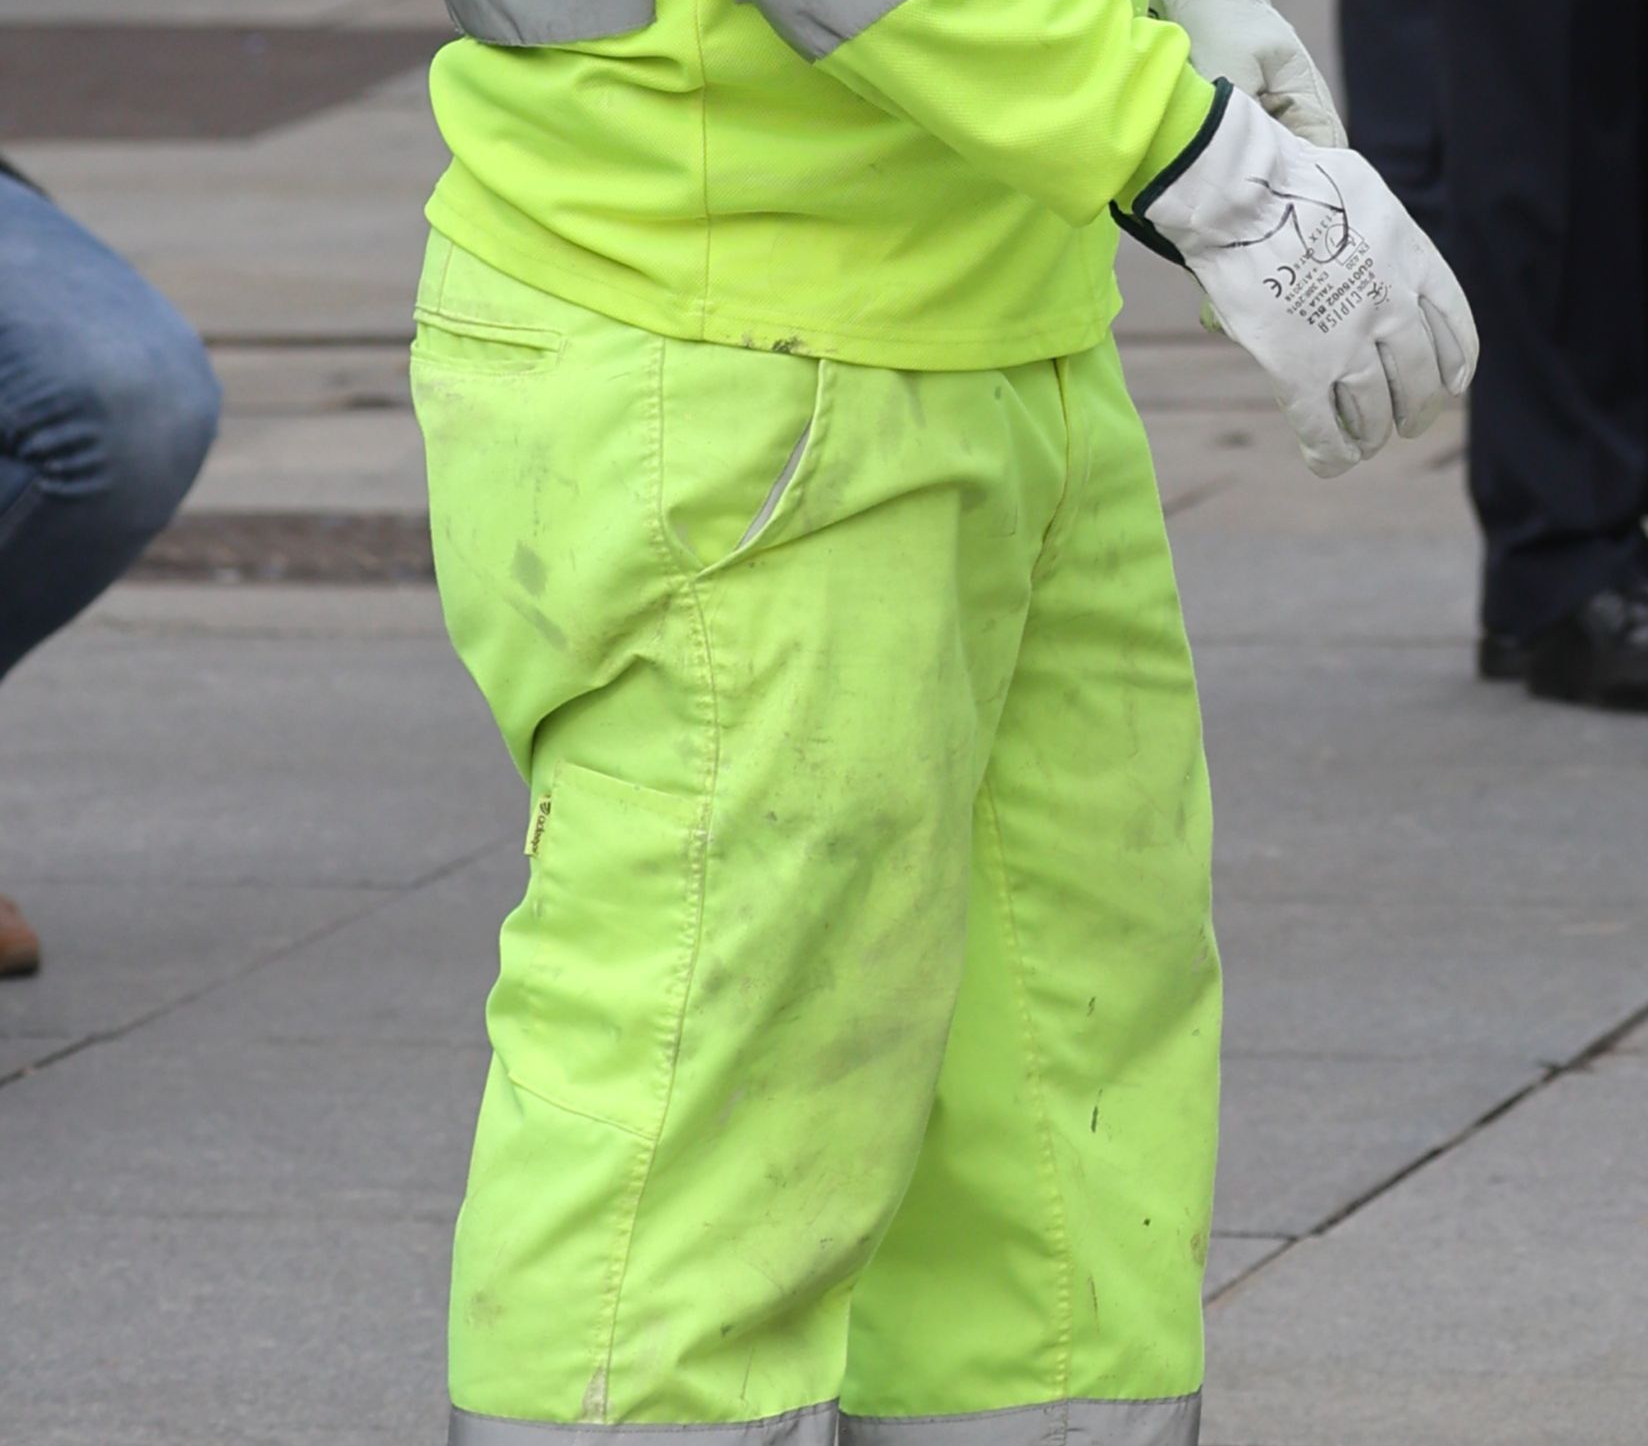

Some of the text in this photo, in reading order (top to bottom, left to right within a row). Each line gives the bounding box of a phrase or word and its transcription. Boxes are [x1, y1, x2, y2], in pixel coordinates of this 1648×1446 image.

[1262, 265, 1296, 299] CE
[1307, 257, 1374, 325] GU015002 BL2
[1309, 283, 1334, 308] TALLA
[1318, 291, 1362, 334] CIPISA
